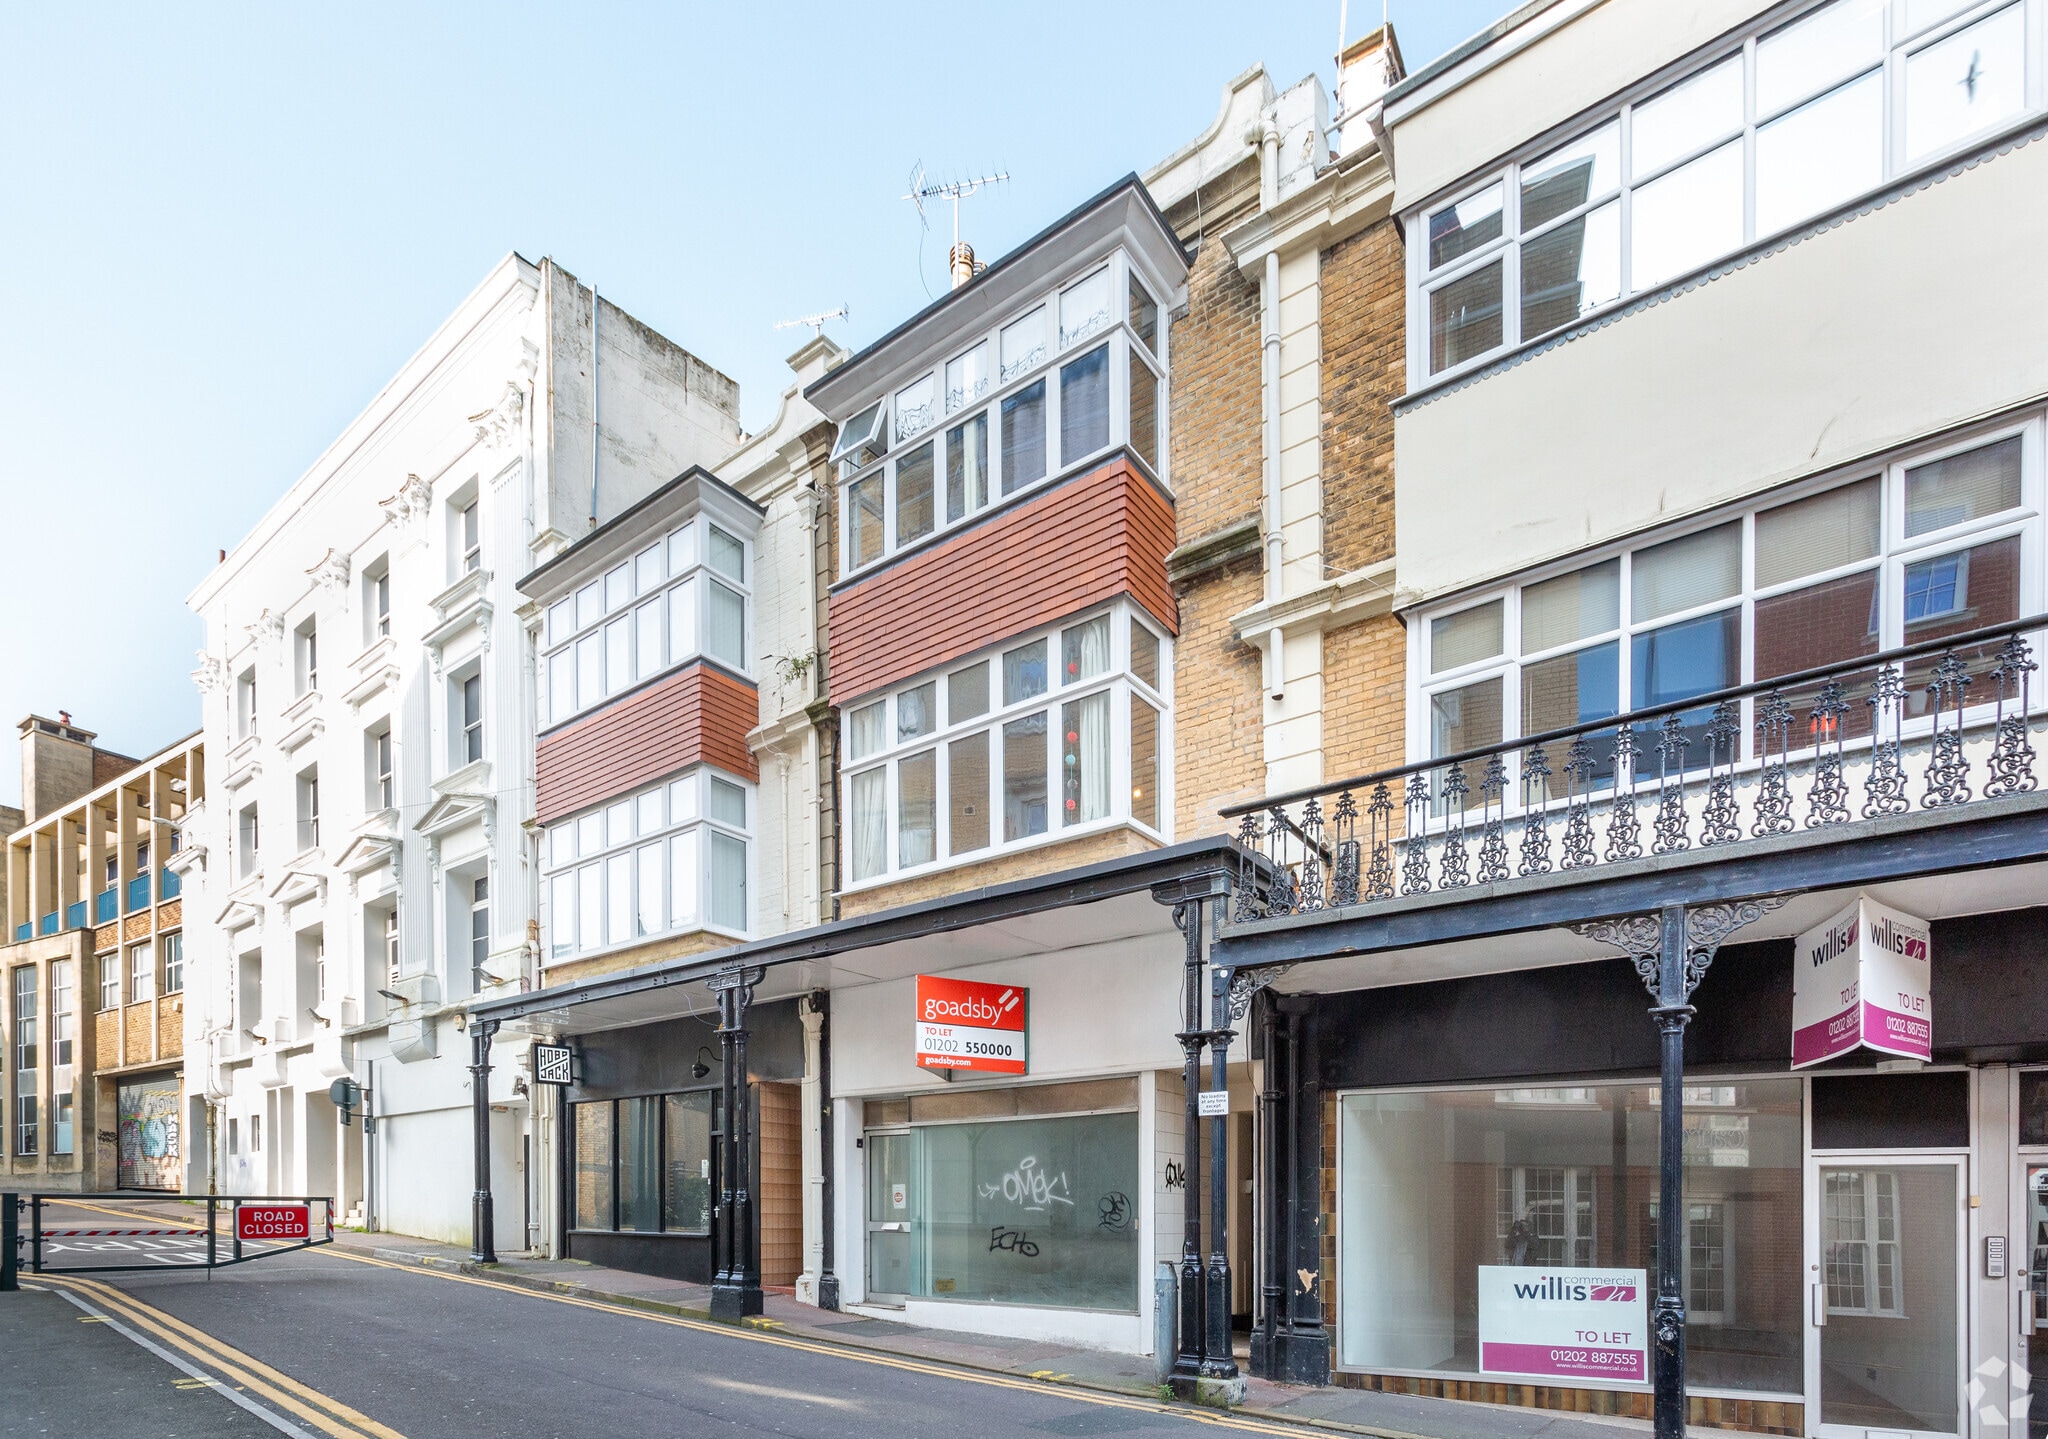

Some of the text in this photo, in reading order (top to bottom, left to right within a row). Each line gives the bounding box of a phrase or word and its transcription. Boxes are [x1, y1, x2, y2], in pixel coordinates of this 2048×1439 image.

[1870, 917, 1903, 955] willis
[1892, 921, 1927, 940] commercial
[1812, 927, 1847, 967] willis
[1841, 990, 1849, 1005] TO
[1897, 992, 1925, 1013] TO LET
[925, 997, 1003, 1026] goadsby
[925, 1026, 953, 1037] TO LET
[1886, 1015, 1929, 1039] 01202 887555
[924, 1038, 1012, 1057] 01202 550000
[540, 1061, 569, 1081] JACK
[924, 1056, 972, 1067] goadsby.com
[253, 1210, 295, 1223] ROAD
[243, 1222, 304, 1236] CLOSED
[989, 1225, 1040, 1257] ECHO
[1513, 1275, 1587, 1301] willis
[1563, 1275, 1637, 1286] commercial
[1575, 1330, 1632, 1344] TO LET
[1550, 1349, 1638, 1366] 01202 887555
[1555, 1362, 1638, 1373] www.williscommercial.co.uk
